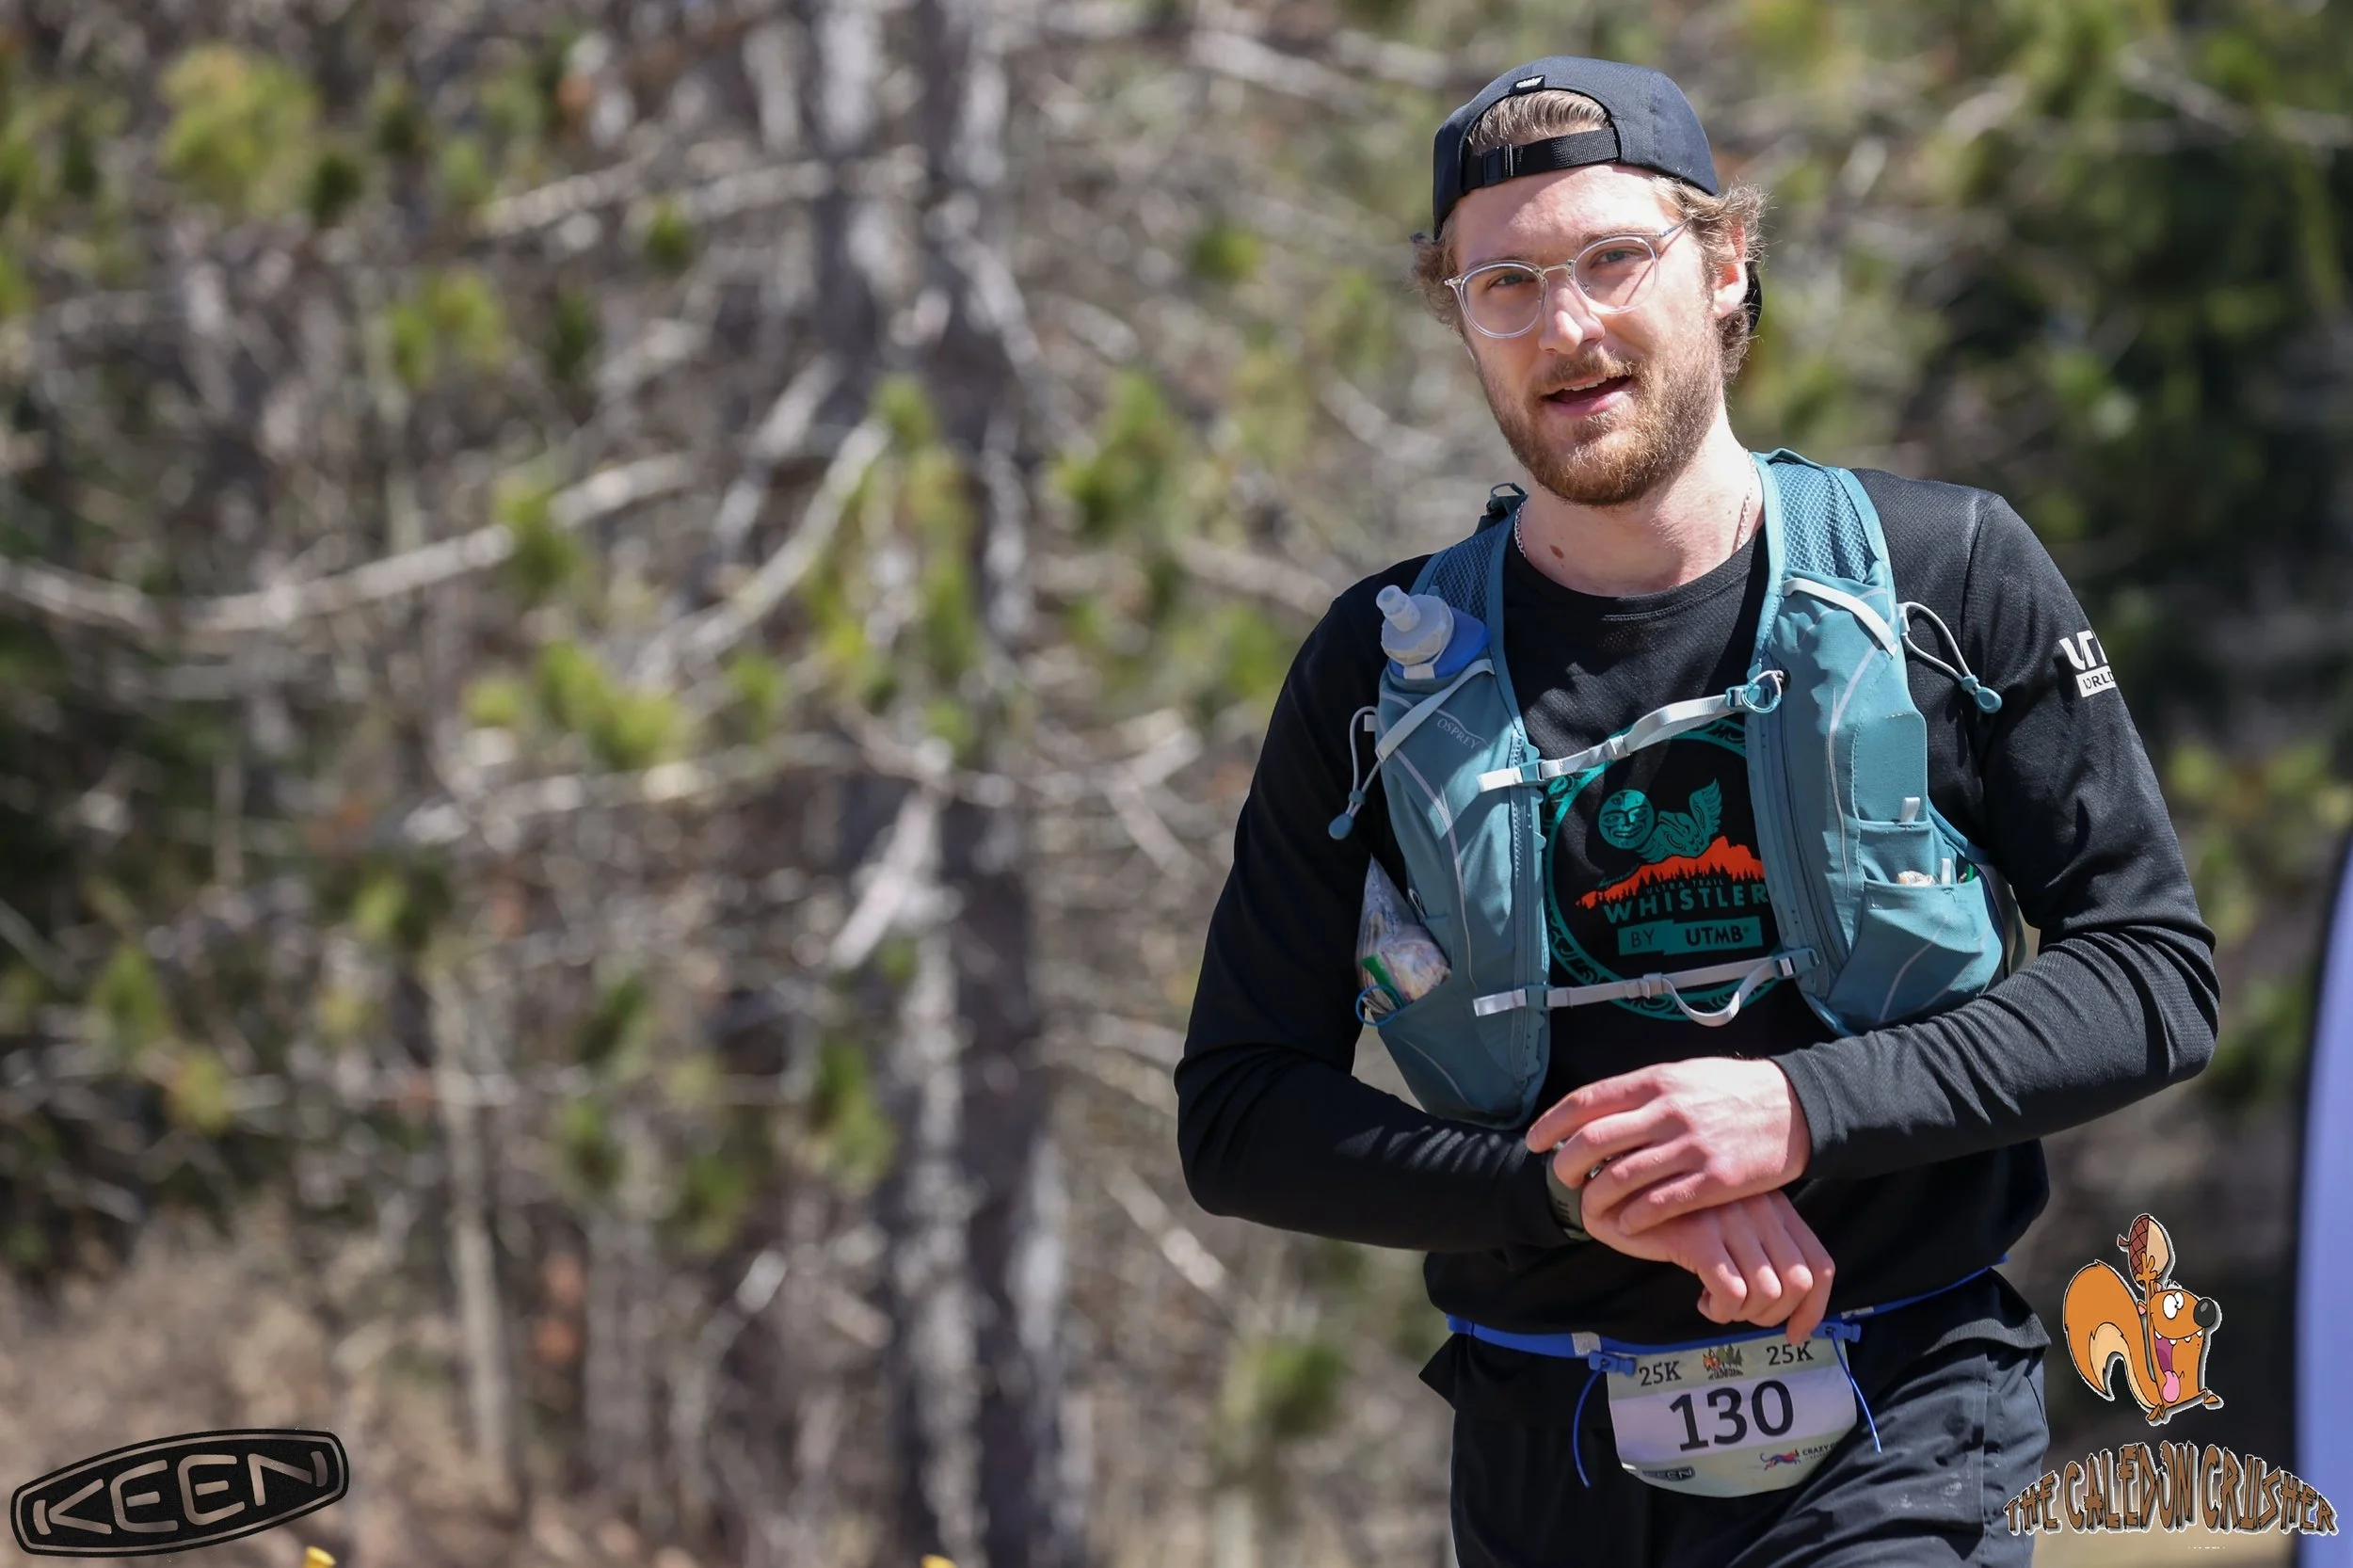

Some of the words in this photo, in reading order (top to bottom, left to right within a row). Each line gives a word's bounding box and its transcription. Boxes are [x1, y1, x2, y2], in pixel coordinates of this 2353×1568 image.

[1436, 717, 1481, 749] OSPREY
[1646, 881, 1685, 894] ULTRA
[1691, 878, 1724, 888] TRAIL
[1602, 883, 1769, 924] WHISTLER
[1630, 927, 1656, 949] BY
[1766, 1340, 1815, 1366] 25K
[1639, 1361, 1682, 1386] 25K
[1669, 1380, 1794, 1452] 130
